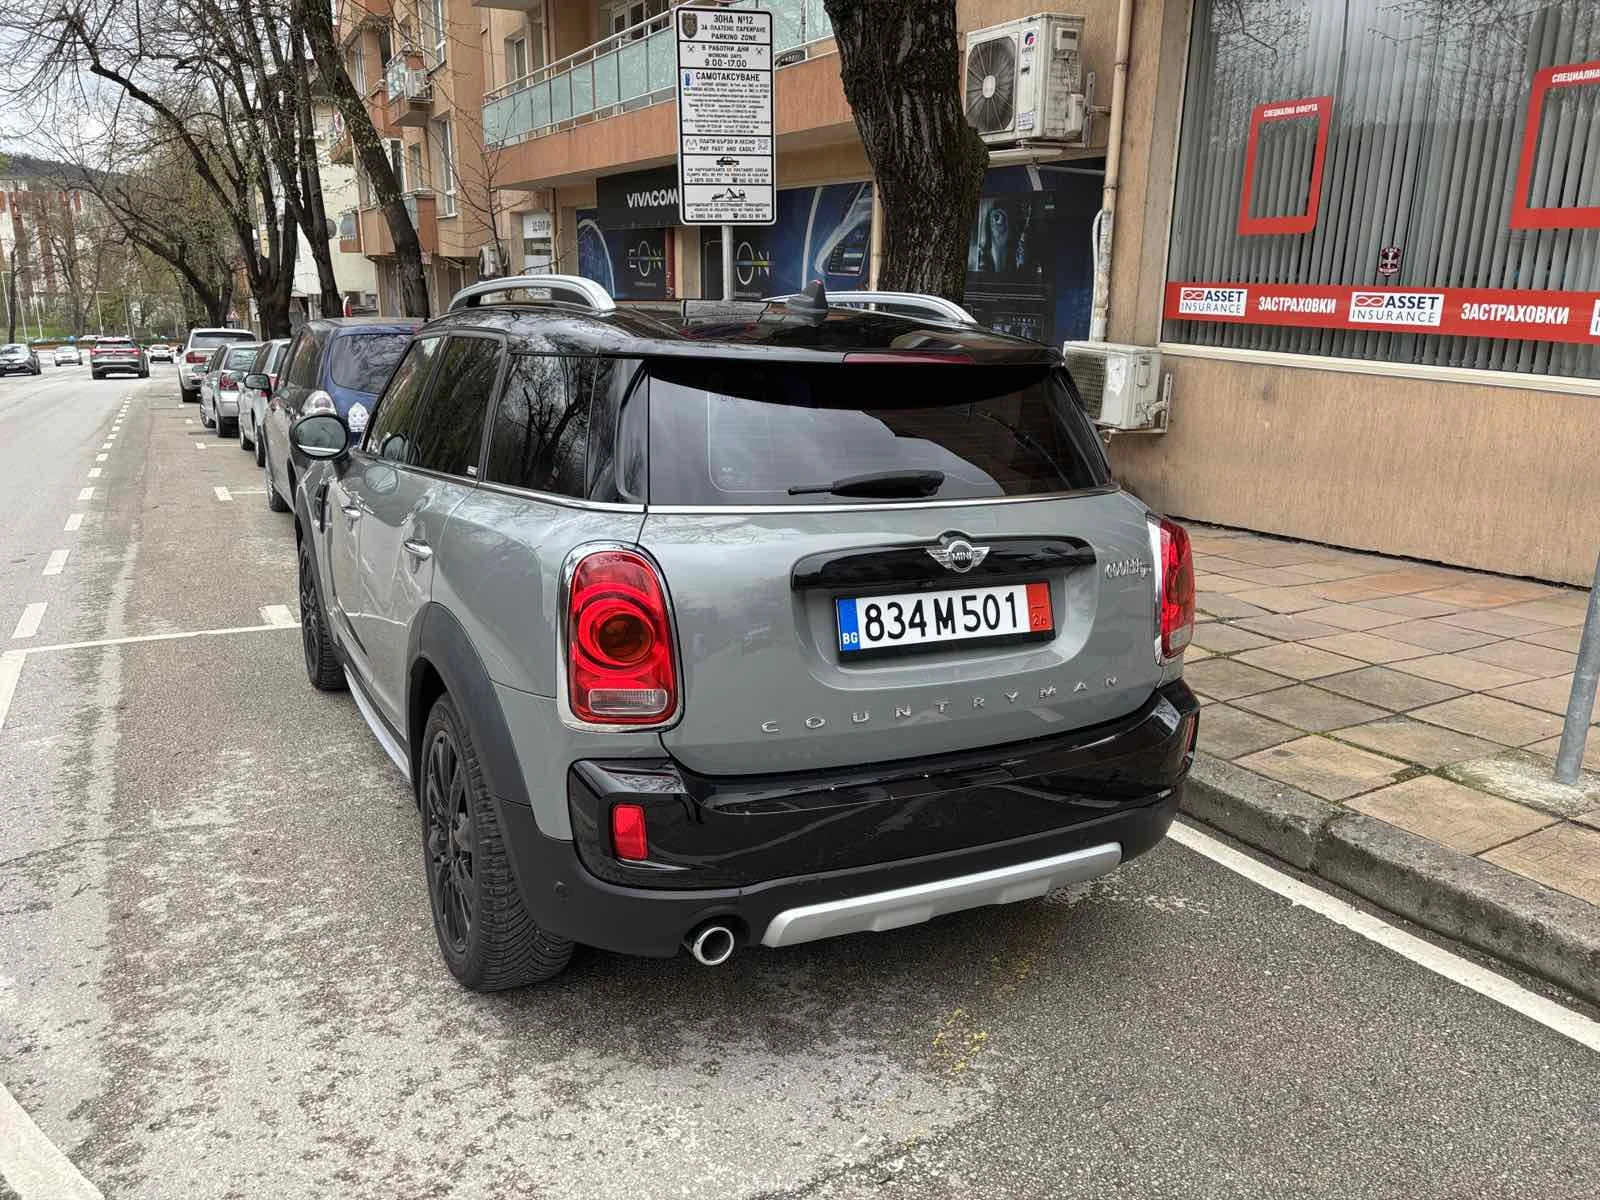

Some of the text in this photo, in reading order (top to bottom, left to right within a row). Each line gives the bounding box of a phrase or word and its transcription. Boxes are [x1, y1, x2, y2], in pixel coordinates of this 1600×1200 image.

[713, 15, 734, 24] ЗОНА
[711, 33, 738, 41] PARKING
[695, 71, 760, 82] САМОТАКСУВАНЕ
[626, 187, 678, 209] VIVACOM
[1205, 290, 1244, 302] ASSET
[1385, 295, 1440, 310] ASSET
[1180, 302, 1242, 313] INSURANCE
[1258, 296, 1337, 314] ЗАСТРАХОВКИ
[1351, 309, 1437, 324] INSURANCE
[1461, 303, 1570, 325] ЗАСТРАХОВКИ
[951, 551, 972, 561] MINI
[843, 632, 858, 645] BG
[760, 676, 1119, 734] COUNTRYMAN
